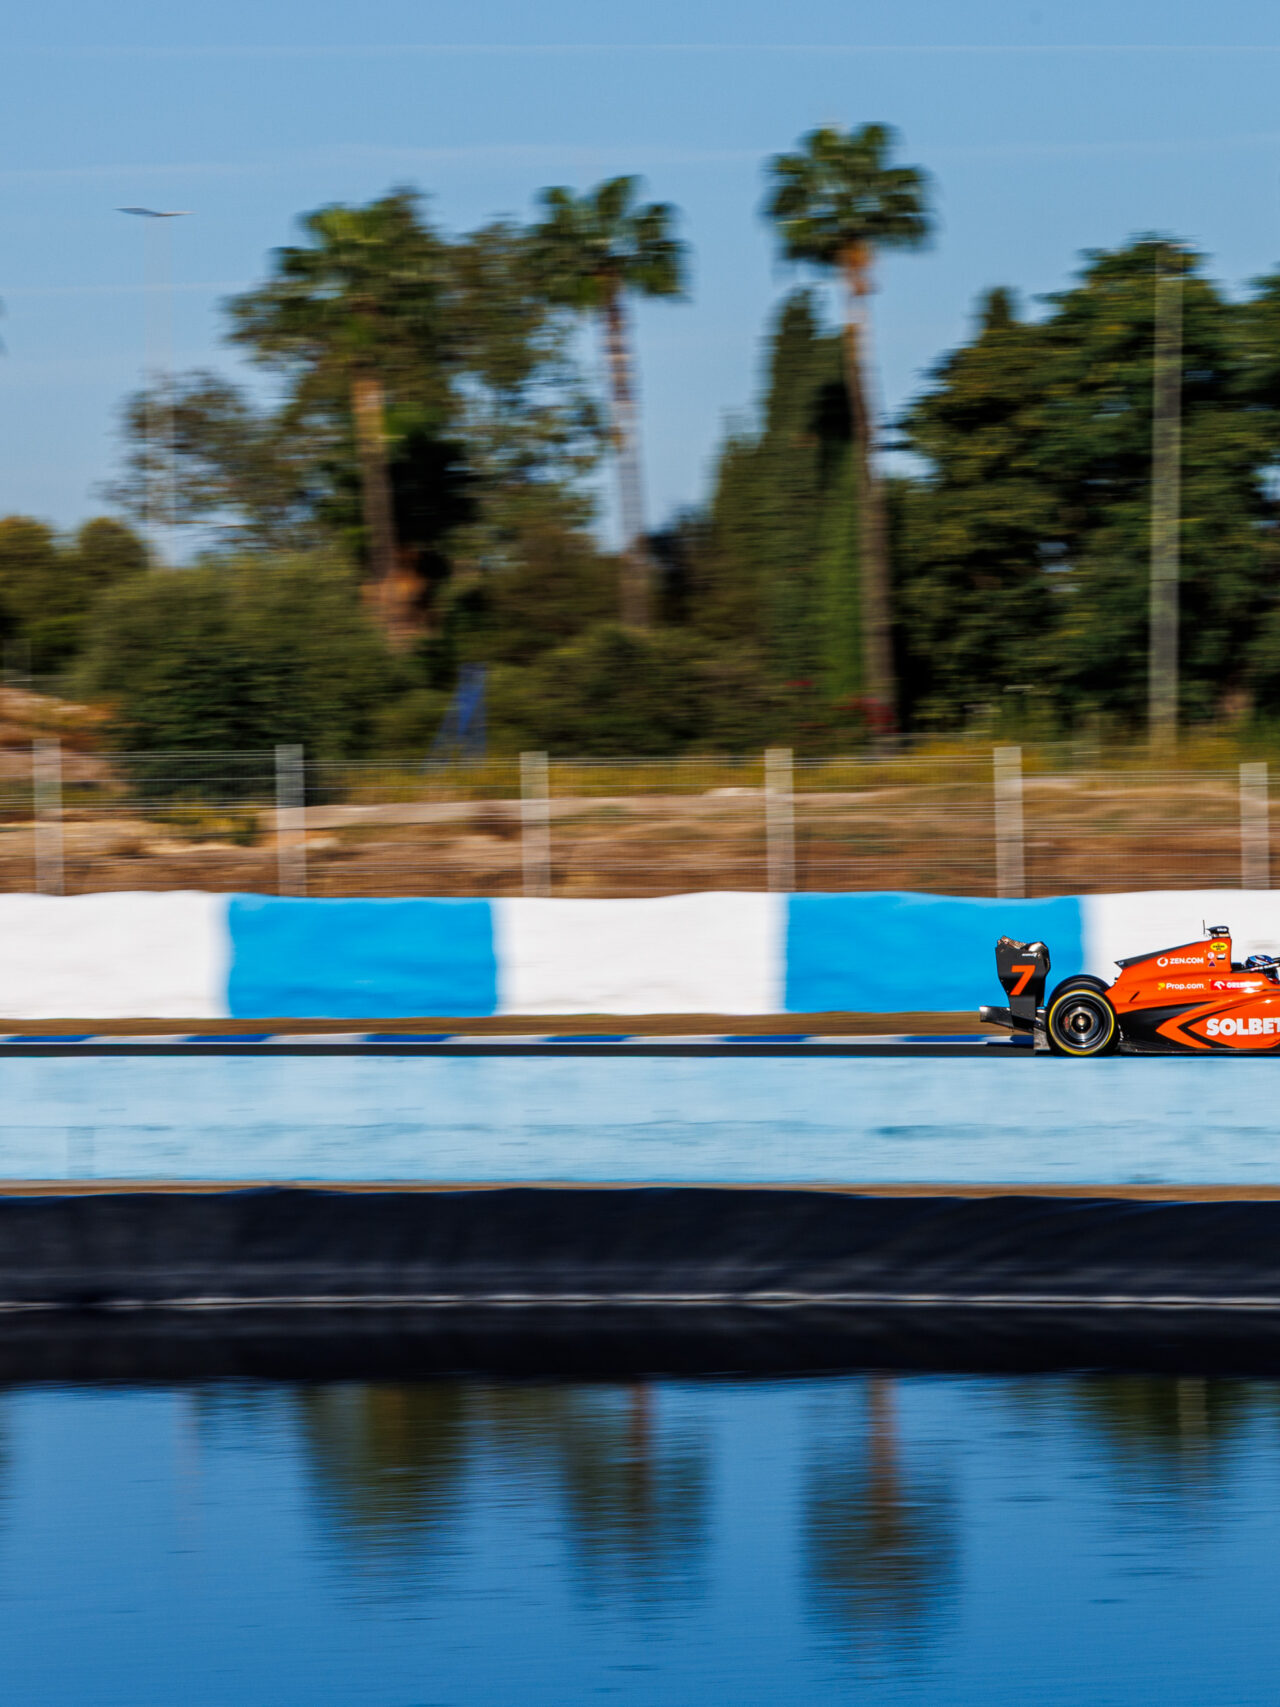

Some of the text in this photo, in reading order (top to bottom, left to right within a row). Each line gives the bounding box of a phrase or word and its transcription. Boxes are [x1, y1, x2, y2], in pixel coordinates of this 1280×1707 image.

[1169, 957, 1204, 965] ZEN.COM
[1010, 964, 1036, 996] 7
[1166, 982, 1204, 990] Prop.com
